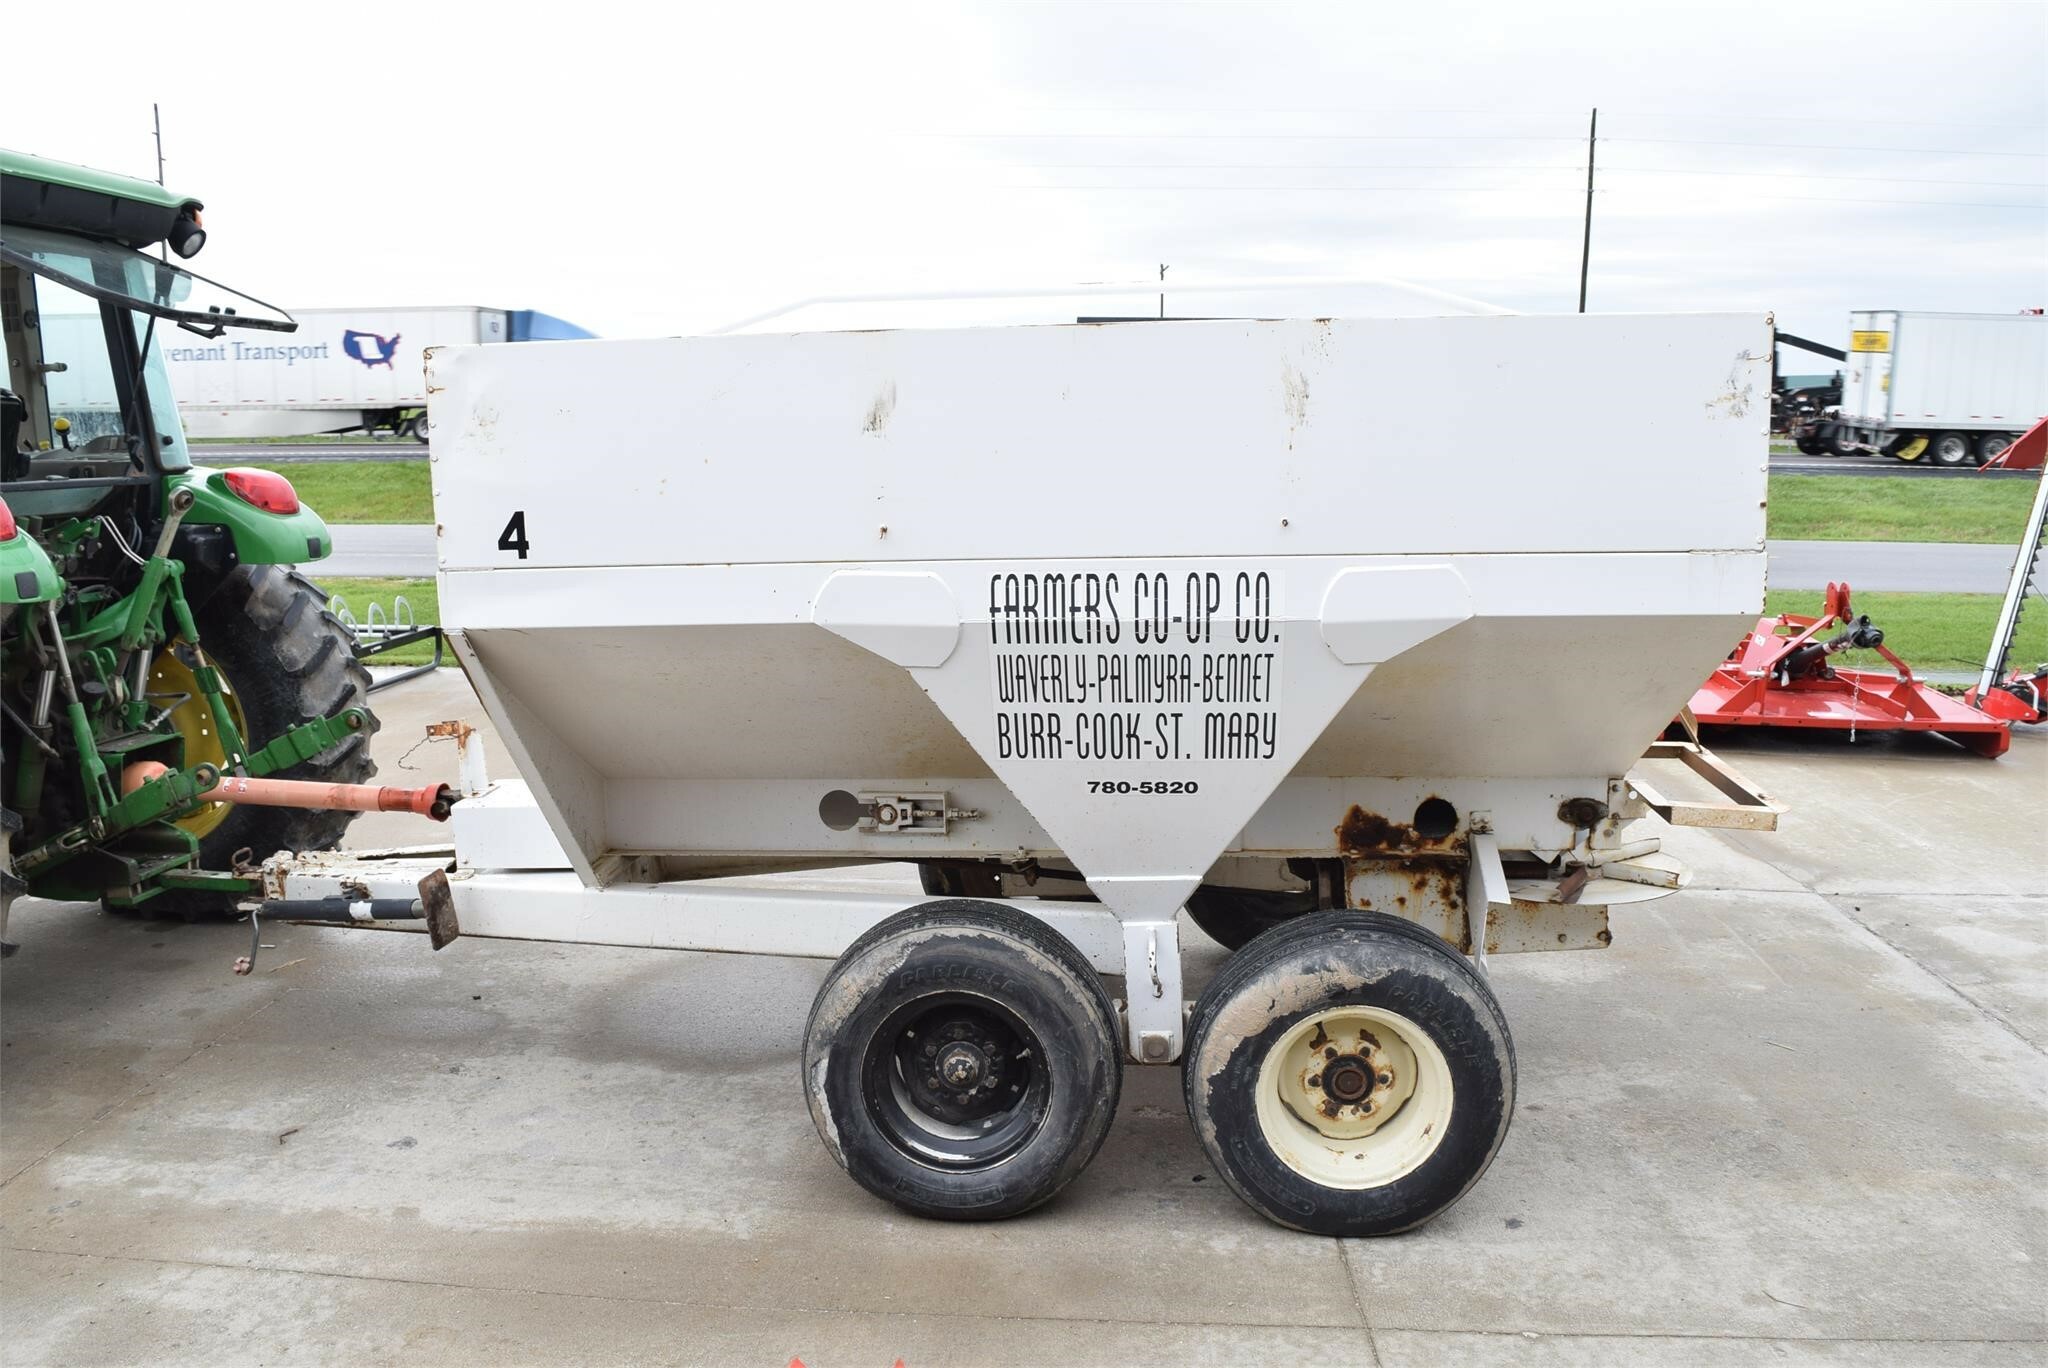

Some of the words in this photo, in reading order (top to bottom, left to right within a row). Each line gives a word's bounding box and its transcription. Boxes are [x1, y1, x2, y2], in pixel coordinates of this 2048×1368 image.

[231, 341, 329, 366] Transport
[498, 511, 529, 559] 4
[990, 573, 1119, 644] FARMERS
[1135, 573, 1219, 644] CO-OP
[1236, 572, 1278, 643] CO.
[997, 654, 1274, 703] WAVERLY-PALMYRA-BENNET
[998, 713, 1190, 759] BURR-COOK-ST.
[1205, 713, 1276, 759] MARY
[1088, 782, 1198, 794] 780-5820
